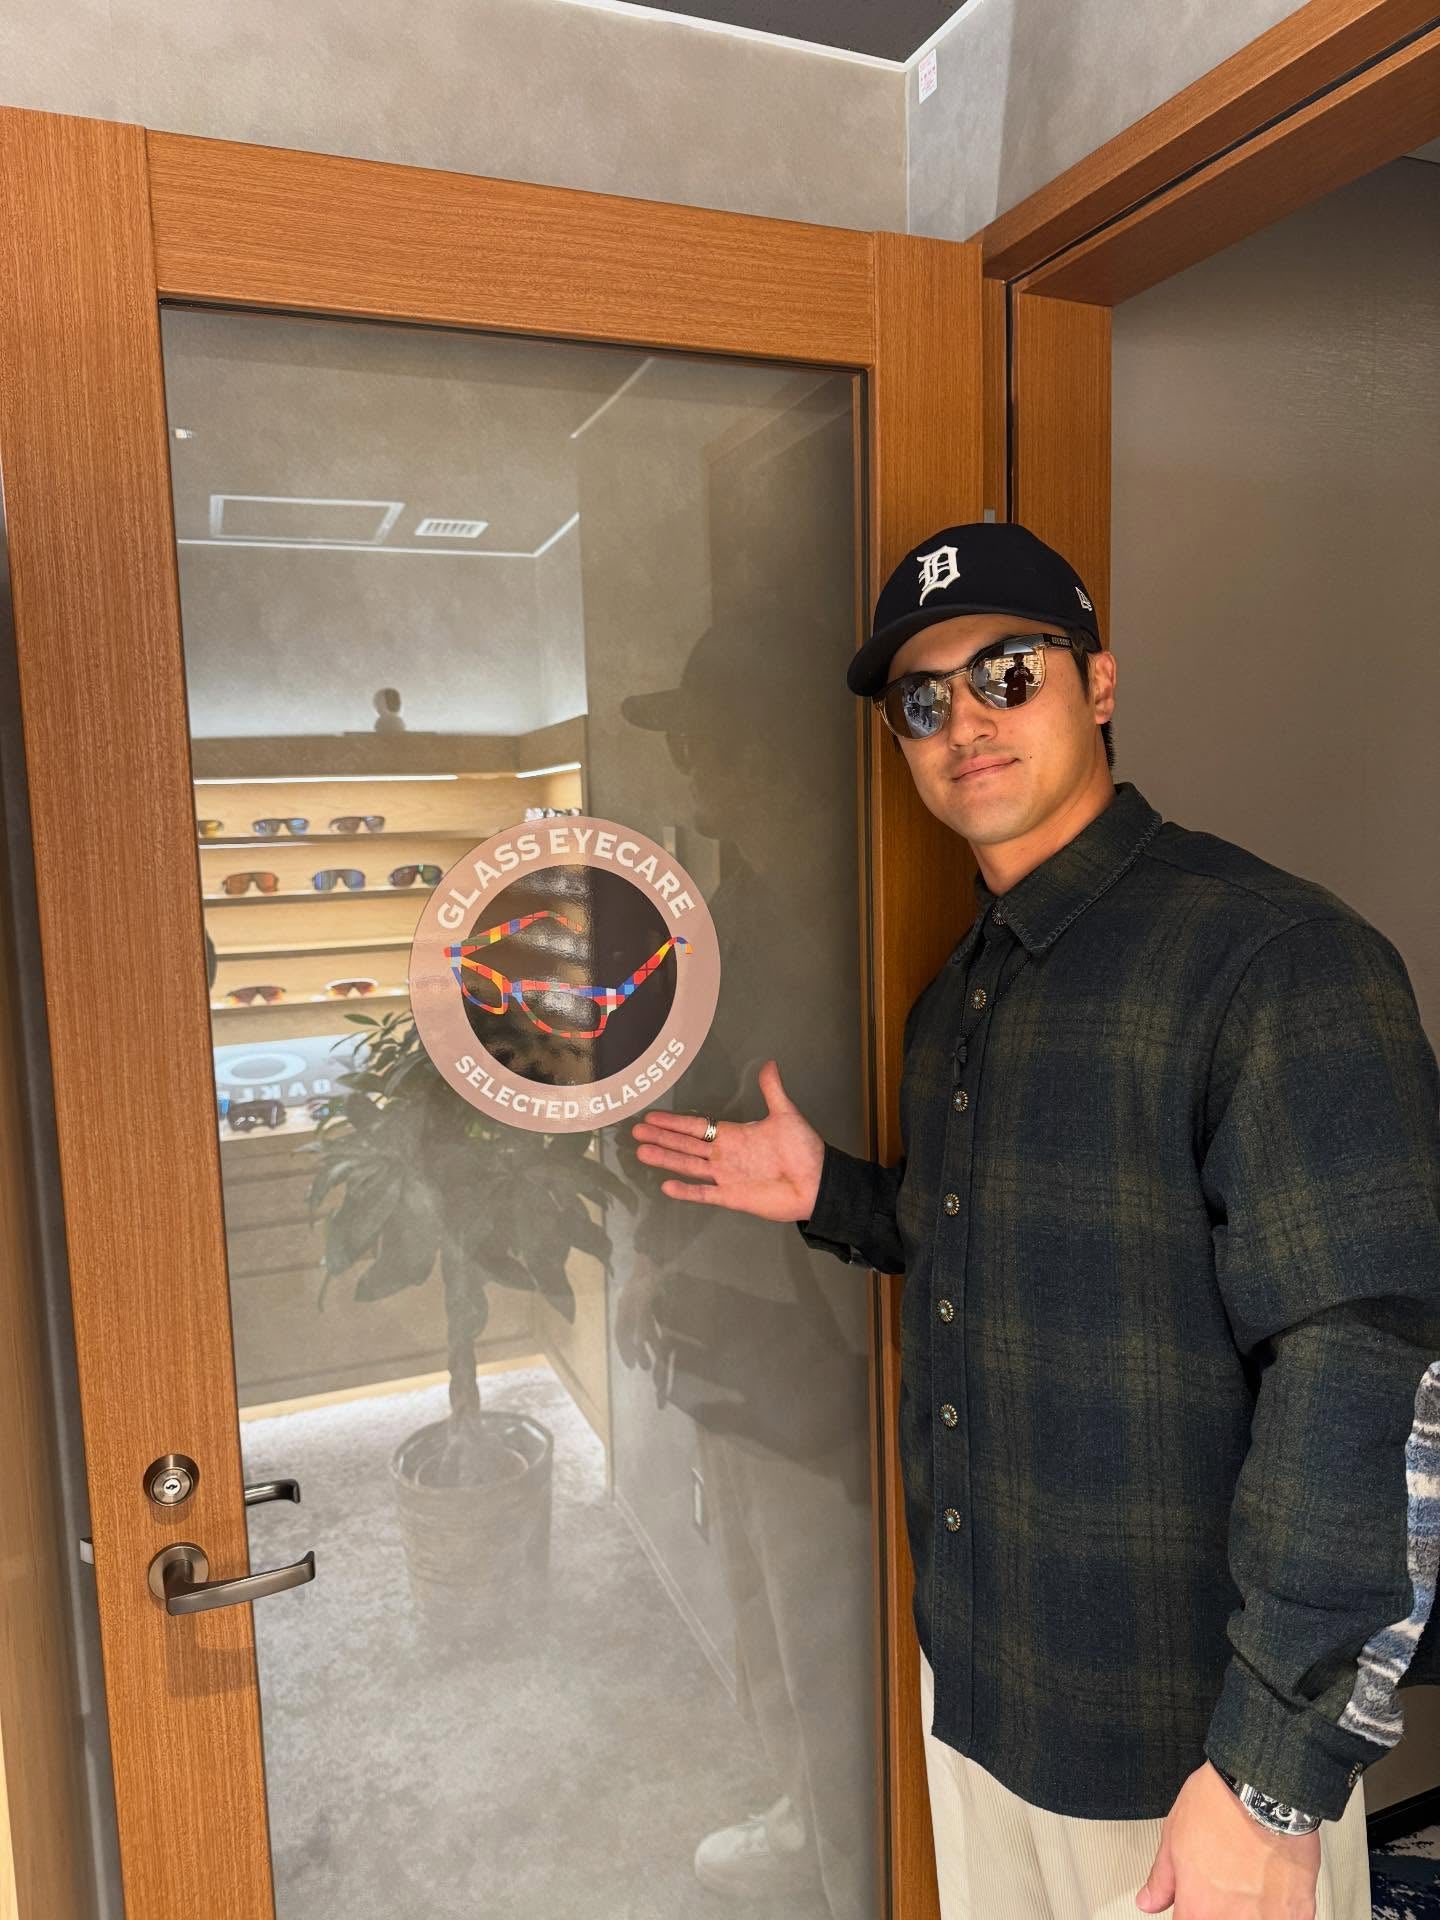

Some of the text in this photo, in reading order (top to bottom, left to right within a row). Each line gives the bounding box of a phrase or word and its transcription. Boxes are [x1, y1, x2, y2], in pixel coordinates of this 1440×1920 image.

[916, 544, 961, 607] D
[437, 827, 696, 929] GLASS EYECARE
[455, 1037, 686, 1119] SELECTED GLASSES
